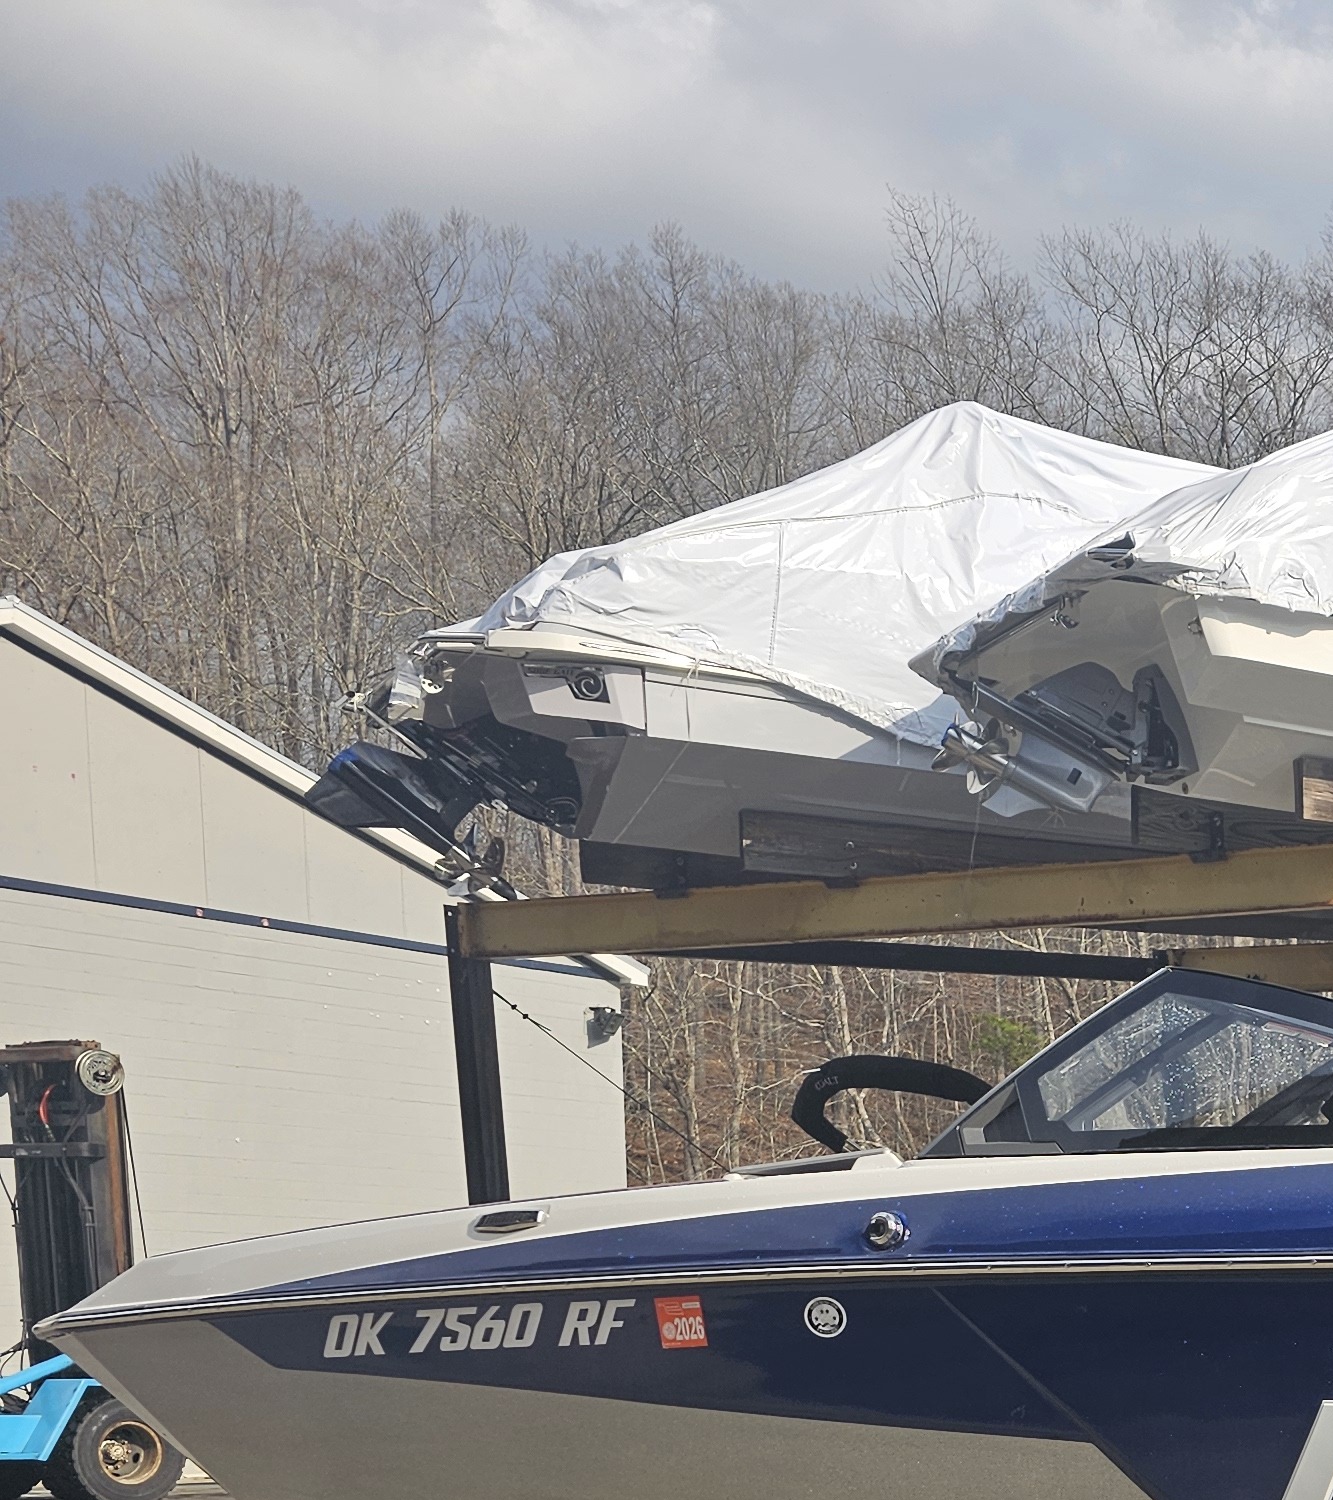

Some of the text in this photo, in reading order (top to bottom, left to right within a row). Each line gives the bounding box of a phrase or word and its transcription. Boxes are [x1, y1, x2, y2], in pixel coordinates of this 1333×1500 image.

[323, 1299, 637, 1358] OK 7560 RF
[673, 1315, 706, 1341] 2026
